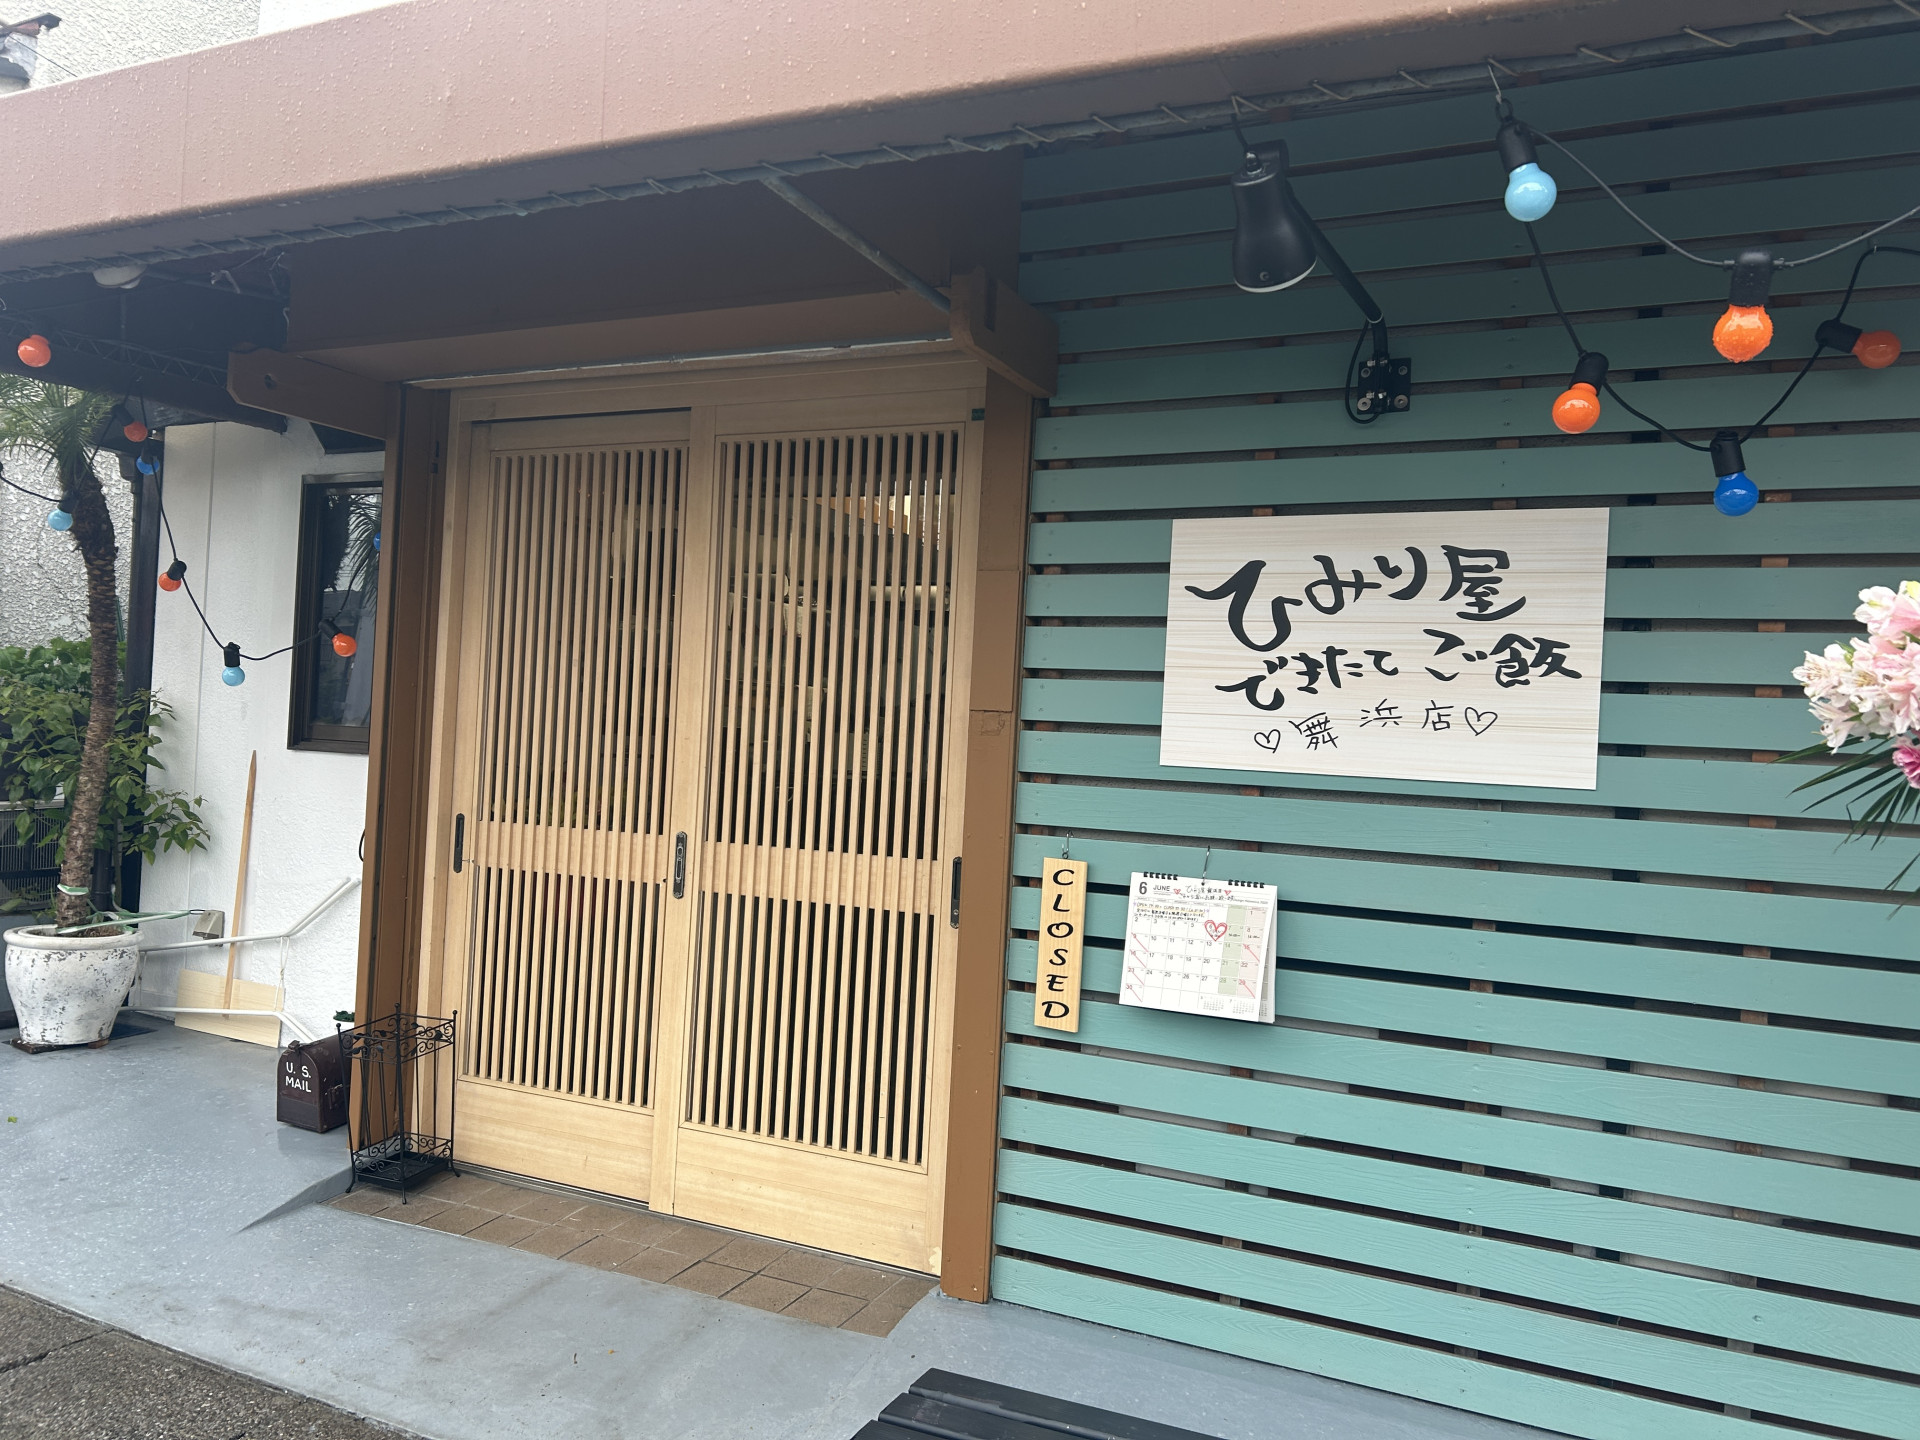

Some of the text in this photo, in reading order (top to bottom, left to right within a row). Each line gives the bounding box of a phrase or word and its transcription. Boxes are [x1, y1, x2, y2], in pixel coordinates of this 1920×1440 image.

[1184, 544, 1527, 652] ひみり屋
[1214, 628, 1583, 711] できたて ご飯
[1139, 881, 1148, 895] 6
[1041, 868, 1075, 1019] CLOSED
[285, 1076, 312, 1093] MAIL
